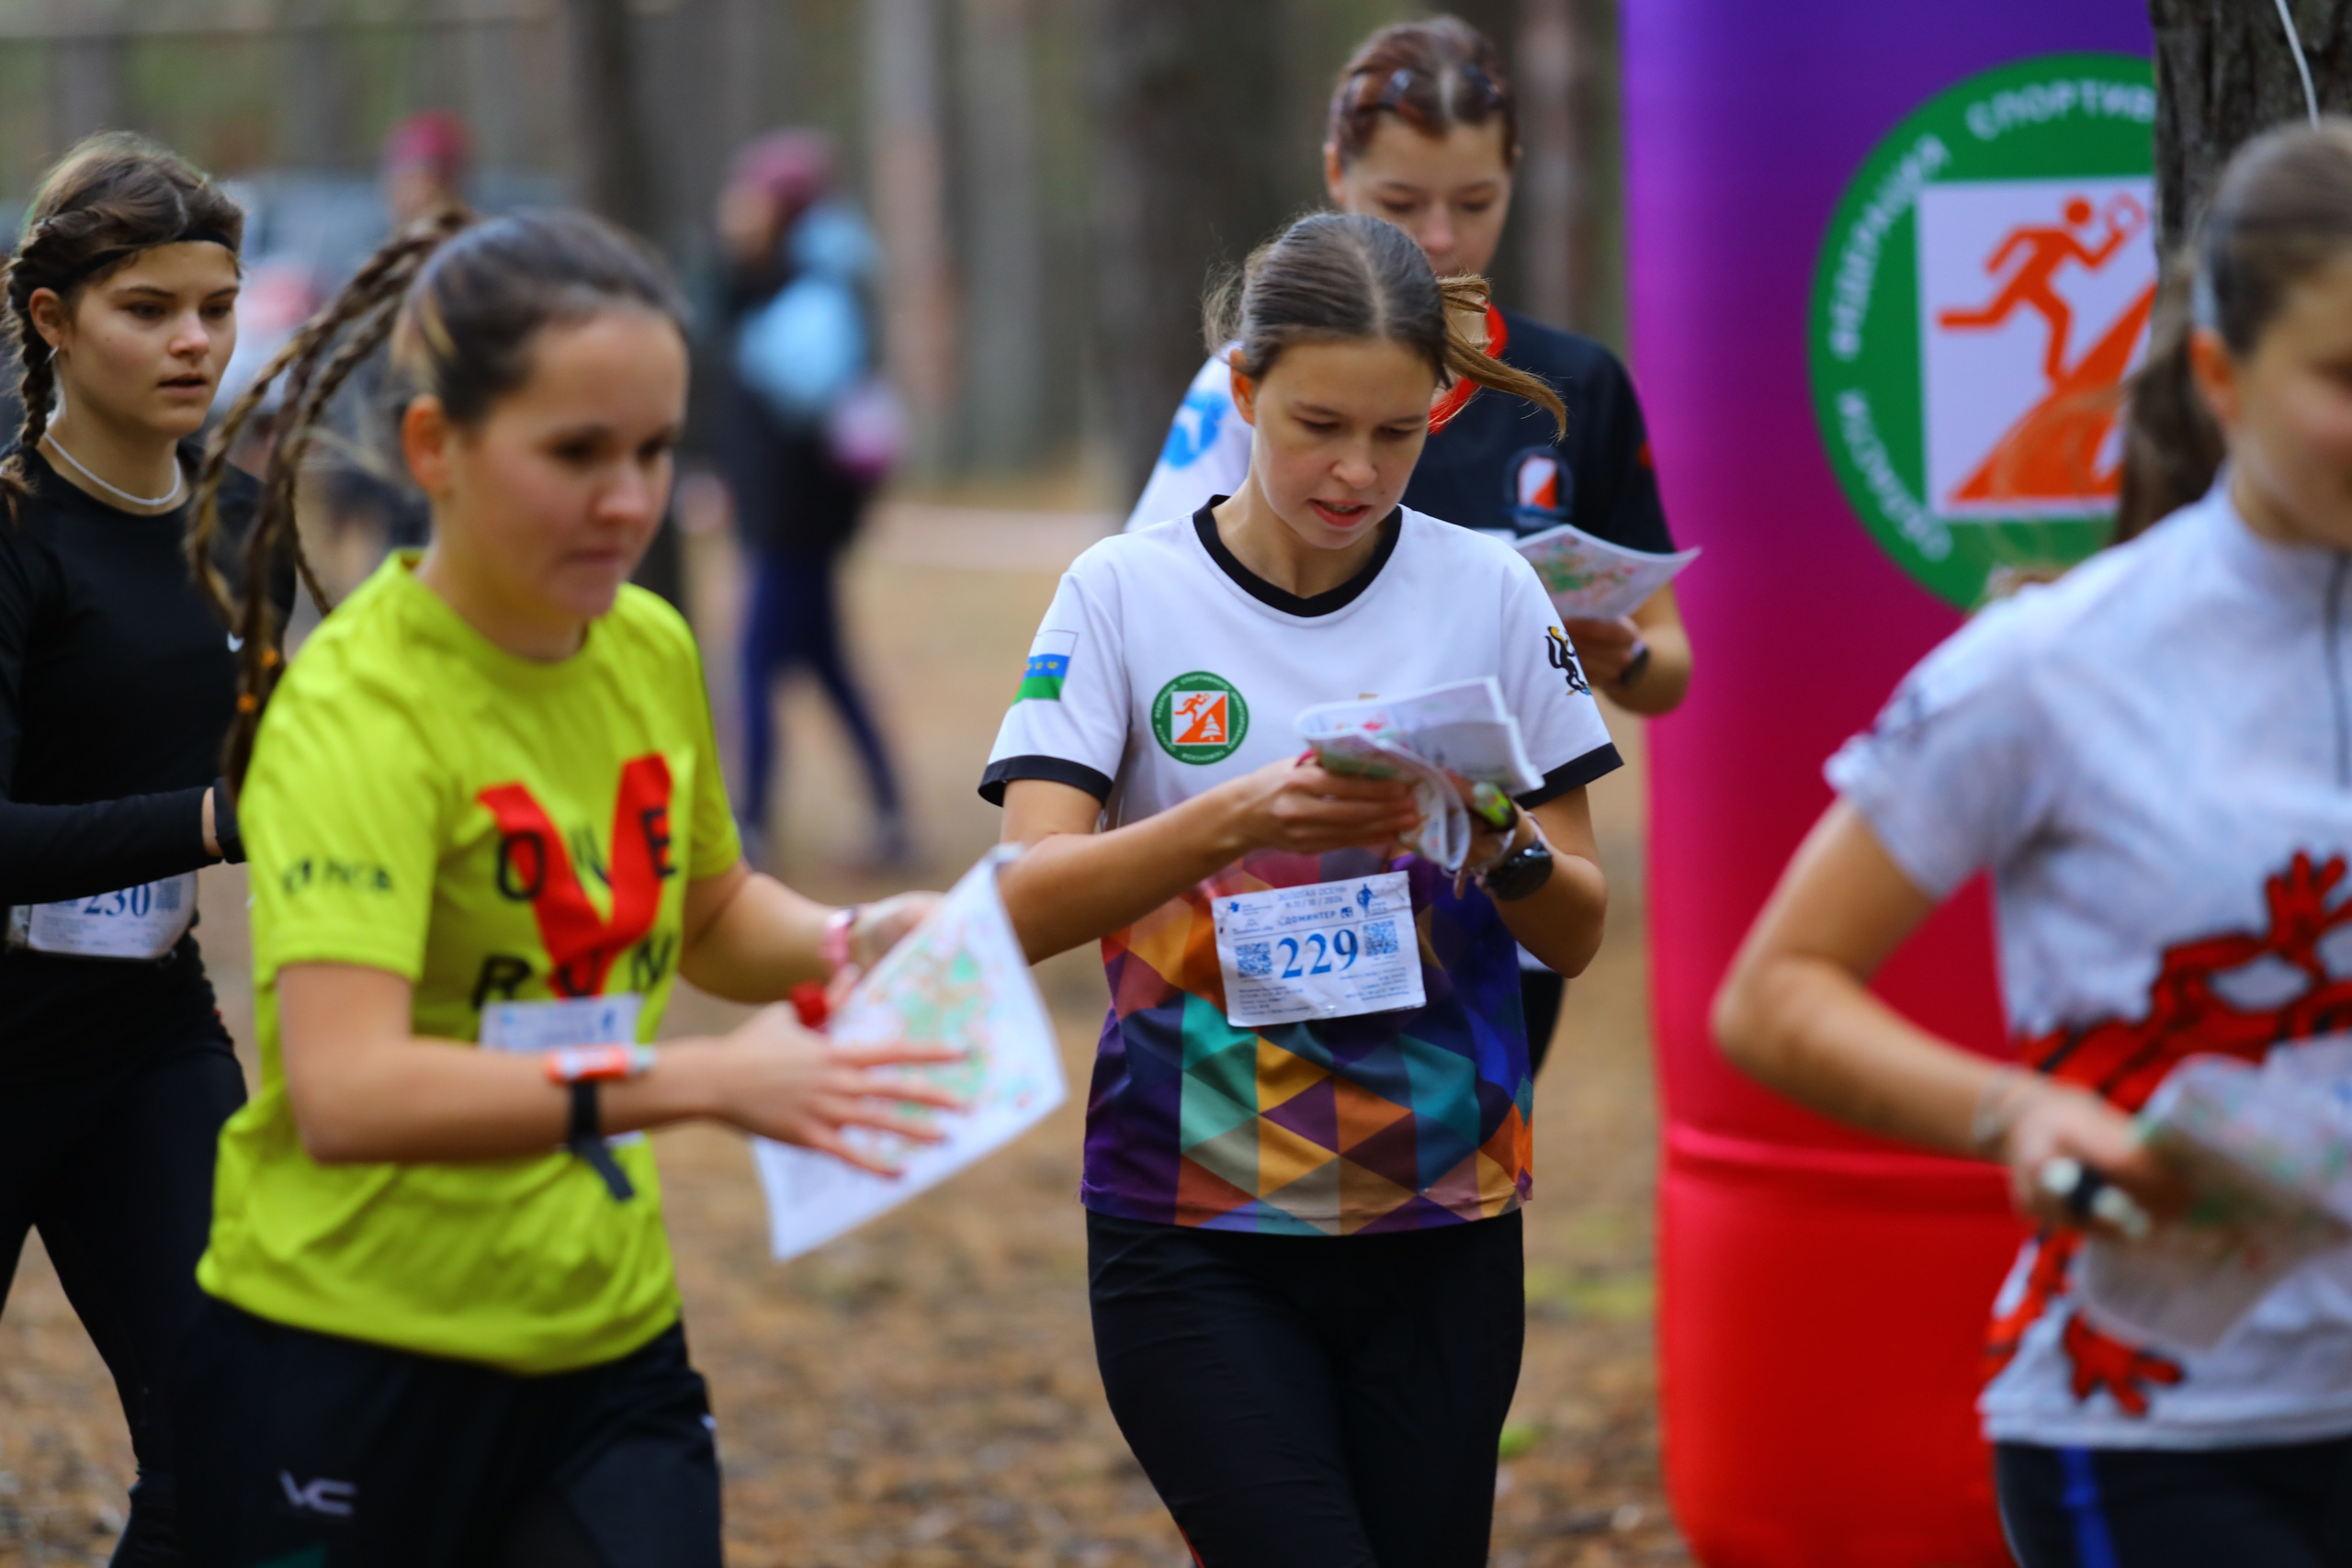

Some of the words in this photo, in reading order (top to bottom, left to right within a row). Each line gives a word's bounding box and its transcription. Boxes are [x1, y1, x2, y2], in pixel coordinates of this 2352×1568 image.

[1829, 135, 1951, 361] ФЕДЕРАЦИЯ
[473, 931, 673, 1011] RUN
[1276, 929, 1360, 980] 229
